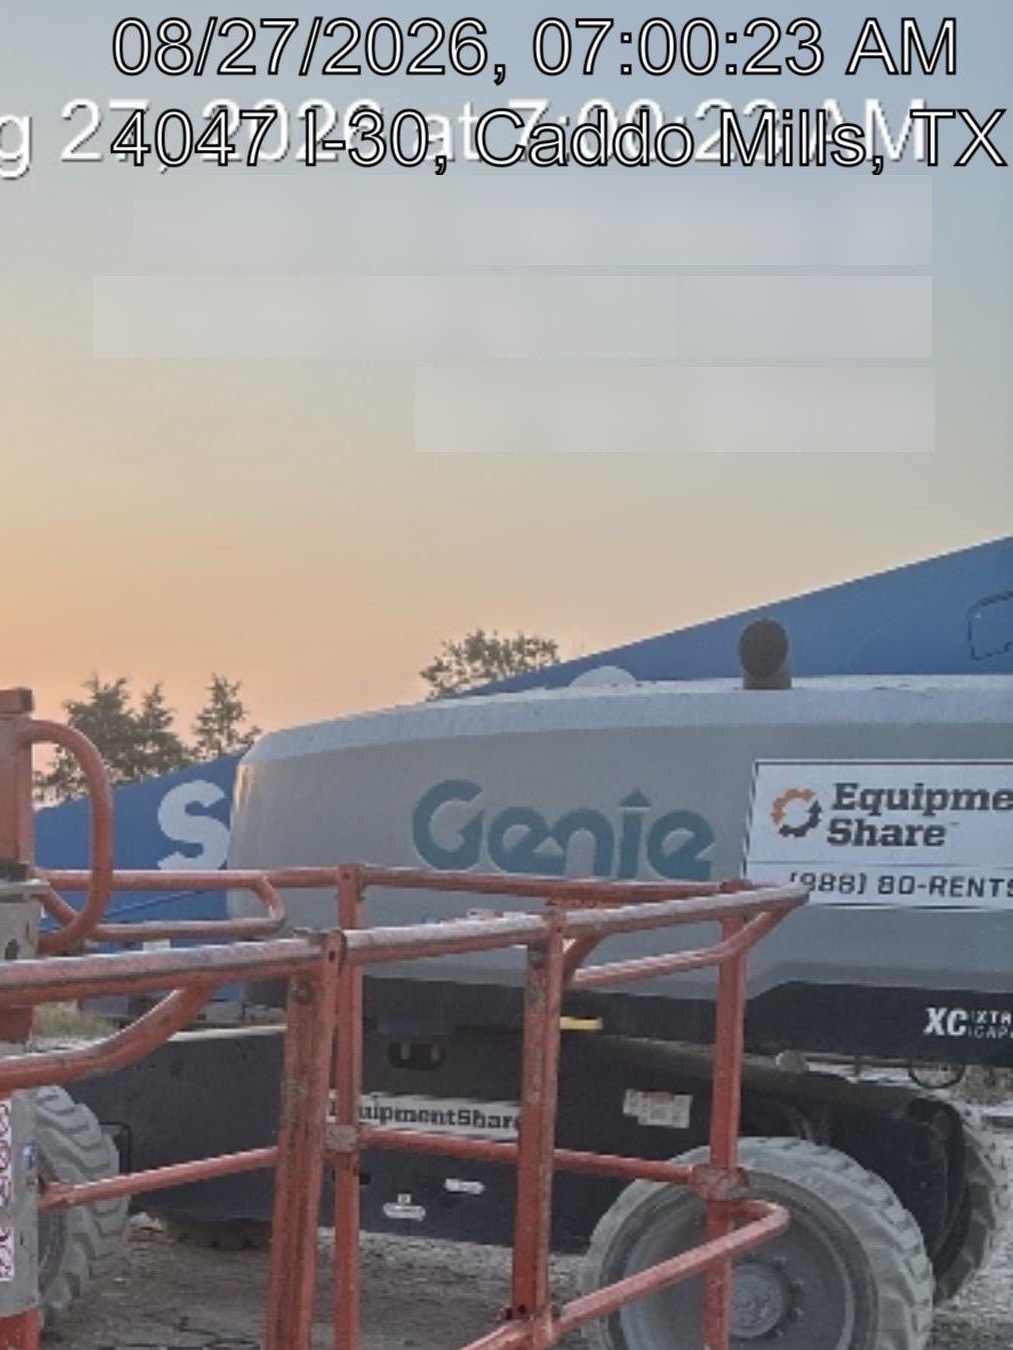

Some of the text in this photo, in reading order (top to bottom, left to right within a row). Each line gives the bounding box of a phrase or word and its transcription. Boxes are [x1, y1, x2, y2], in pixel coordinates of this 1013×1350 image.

[157, 779, 231, 870] S
[412, 779, 715, 881] Genie
[826, 817, 946, 847] Share
[923, 1007, 968, 1036] XC
